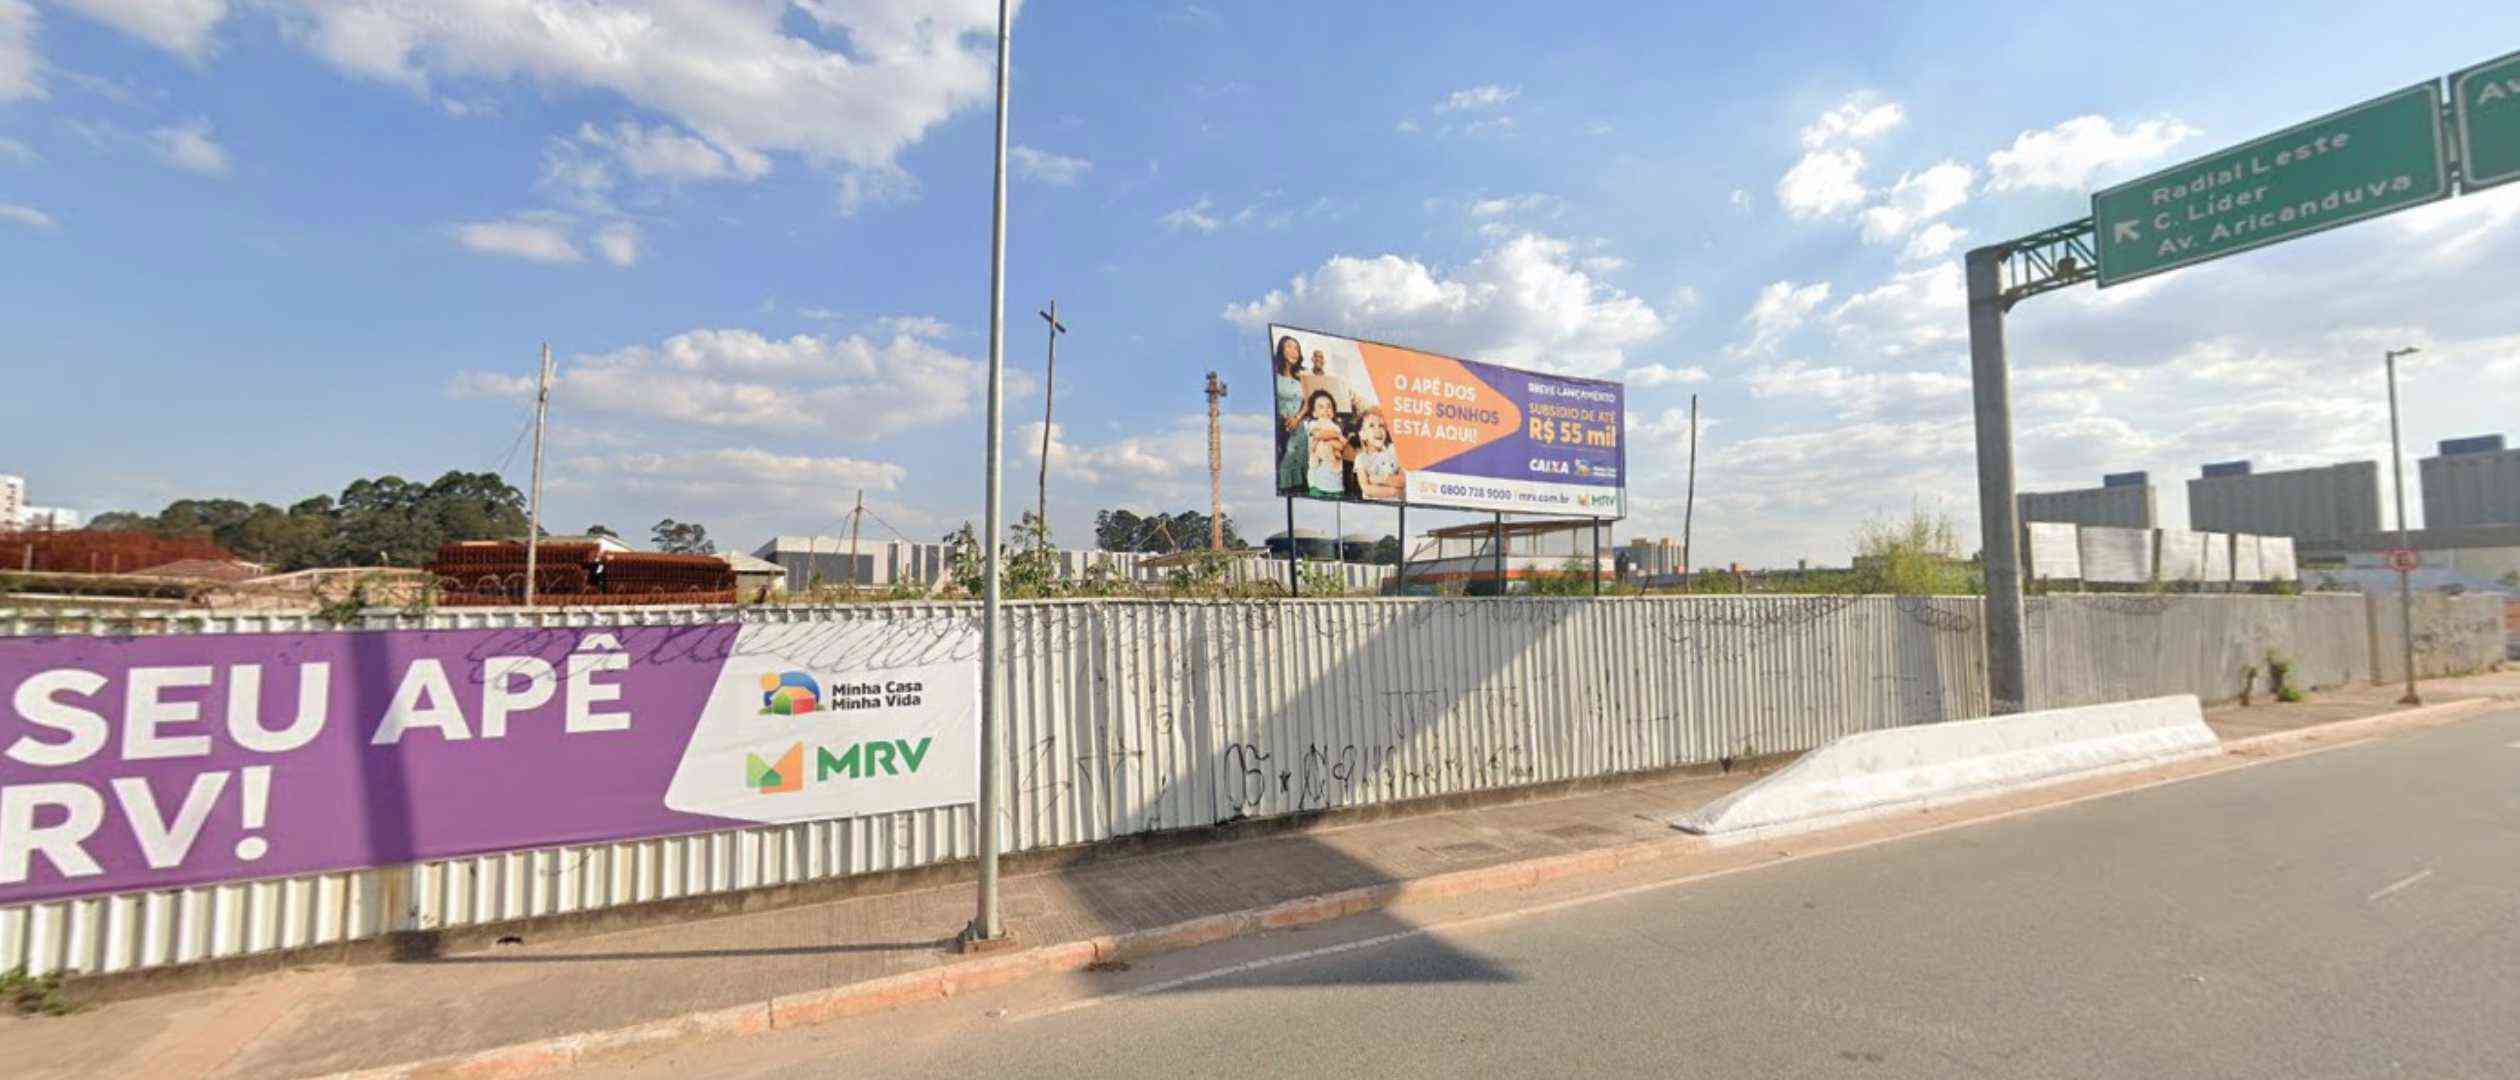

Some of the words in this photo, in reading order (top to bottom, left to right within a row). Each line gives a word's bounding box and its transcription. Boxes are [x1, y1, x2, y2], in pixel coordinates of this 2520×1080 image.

[2153, 160, 2242, 205] Radial
[2252, 134, 2349, 174] Leste
[2154, 212, 2180, 230] C.
[2158, 234, 2199, 256] Av.
[2210, 173, 2413, 242] Aricanduva
[1394, 374, 1408, 390] O
[1411, 376, 1441, 397] APÉ
[1444, 382, 1477, 402] DOS
[1393, 396, 1432, 416] SEUS
[1436, 401, 1500, 425] SONHOS
[1581, 408, 1596, 421] DE
[1393, 417, 1431, 438] ESTÁ
[1434, 424, 1478, 444] AQUI!
[1529, 417, 1555, 444] R$
[1560, 421, 1582, 444] 55
[1588, 424, 1616, 448] mil
[1529, 458, 1569, 474] CAIXA
[1441, 484, 1466, 497] 0800
[1487, 488, 1512, 500] 9000
[1591, 495, 1616, 507] MRV
[4, 662, 330, 767] SEU
[371, 633, 632, 746] APÊ
[832, 683, 881, 697] Minha
[886, 681, 922, 694] Casa
[832, 697, 881, 711] Minha
[885, 694, 922, 707] Vida
[817, 737, 932, 782] MRV
[0, 765, 272, 884] RV!
